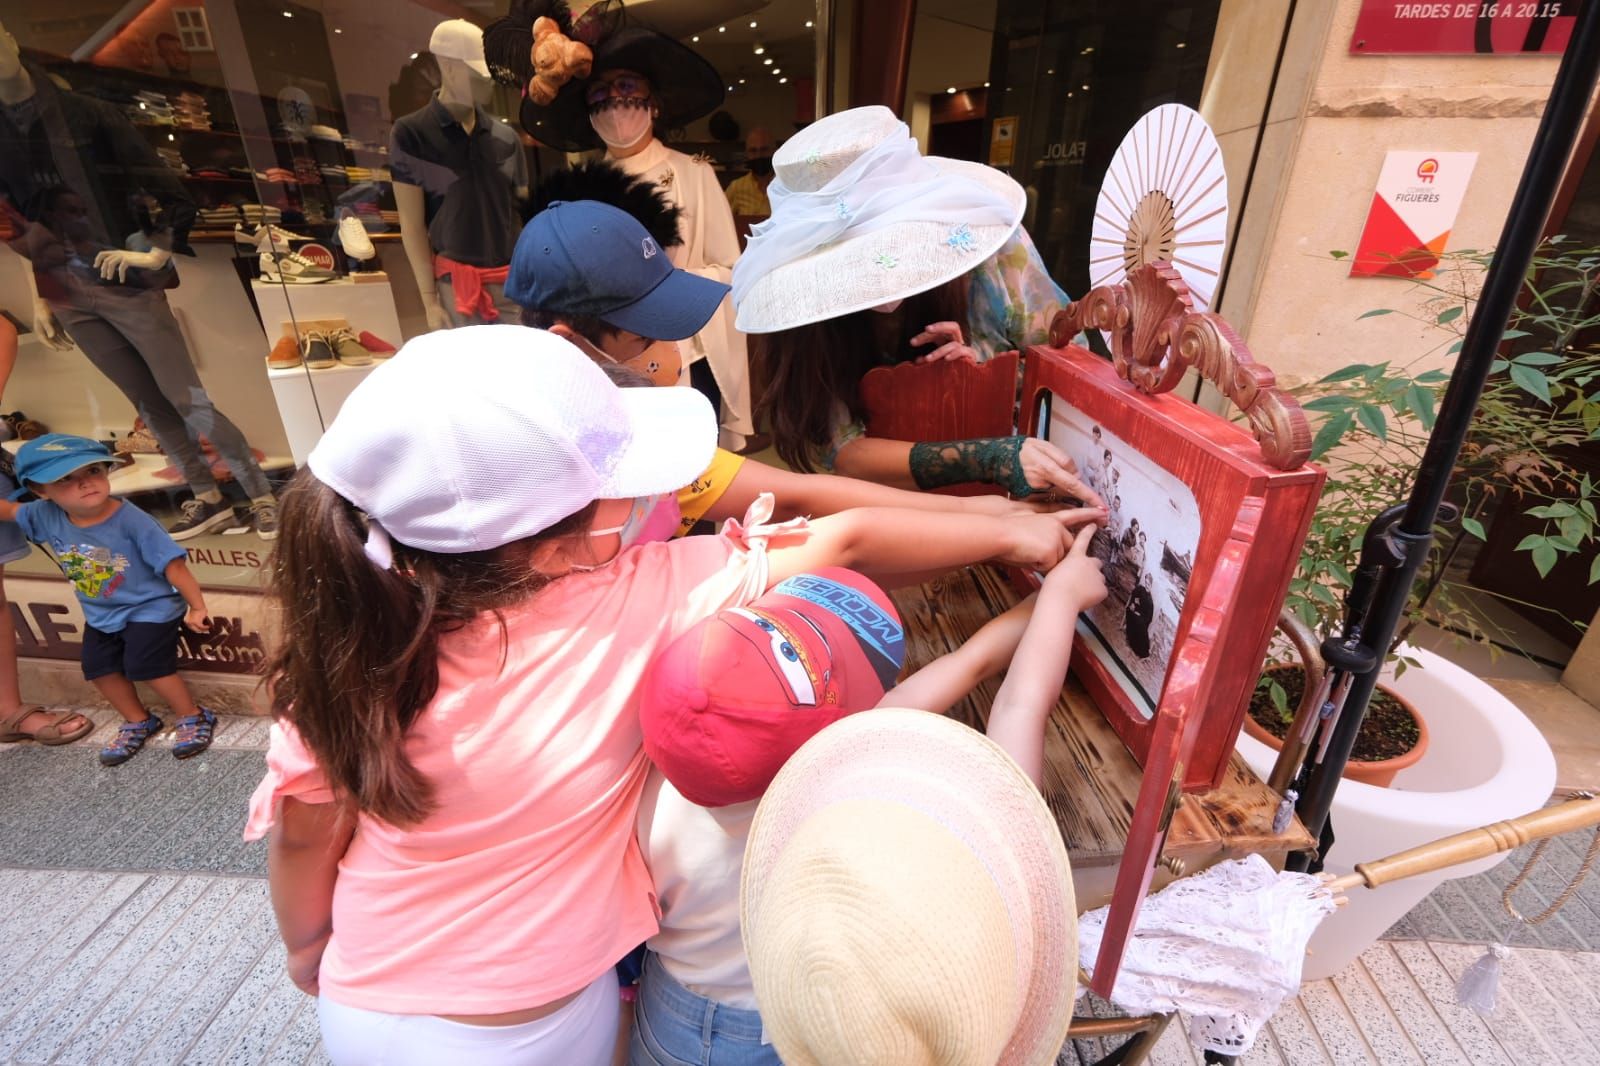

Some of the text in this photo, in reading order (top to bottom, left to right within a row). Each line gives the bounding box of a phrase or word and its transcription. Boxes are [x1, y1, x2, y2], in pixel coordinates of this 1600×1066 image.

[1394, 3, 1561, 18] TARDES DE 16 A 20.15
[1395, 193, 1440, 203] FIGUERES
[783, 575, 904, 644] MCQUEEN
